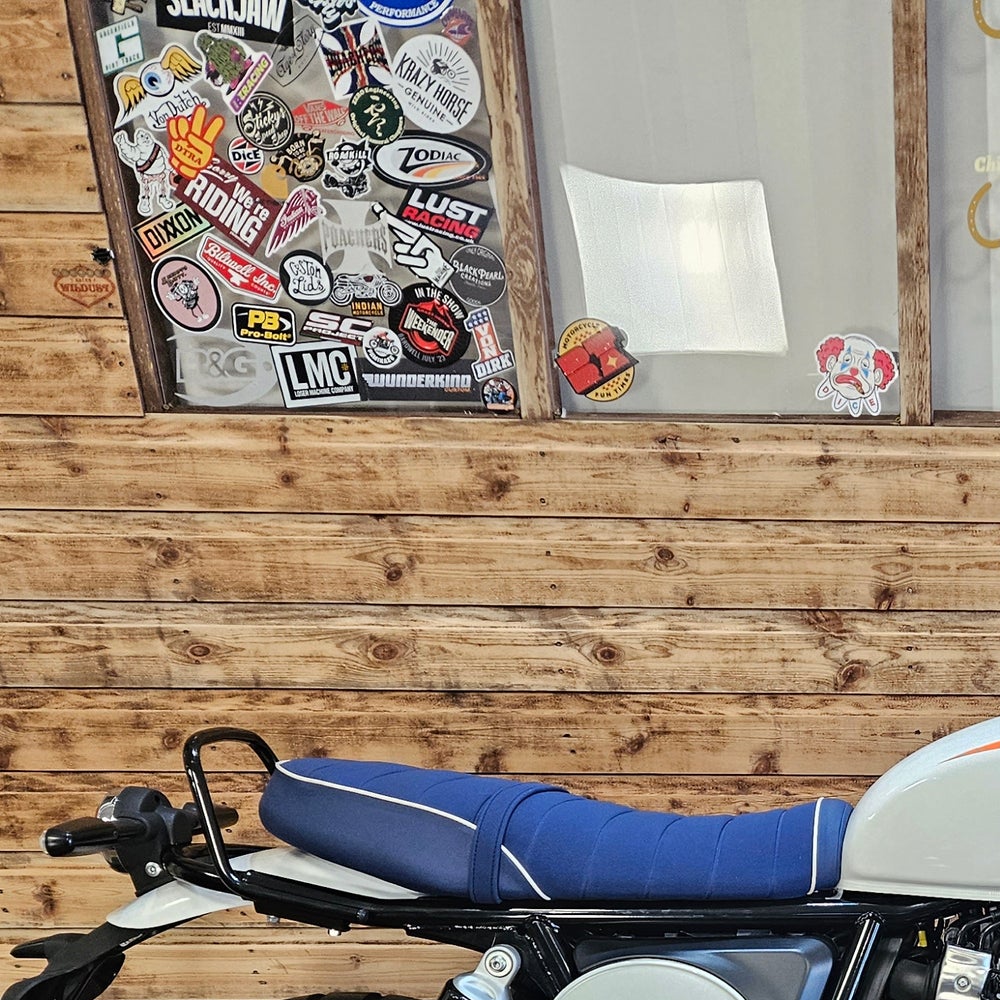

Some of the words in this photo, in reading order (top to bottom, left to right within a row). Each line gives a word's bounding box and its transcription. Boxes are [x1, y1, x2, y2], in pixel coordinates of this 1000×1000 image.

[368, 0, 440, 19] PERFORMANCE
[207, 21, 220, 33] EST
[394, 52, 435, 93] KRAZY
[433, 83, 473, 125] HORSE
[404, 87, 446, 122] GENUINE
[174, 143, 203, 165] DTRA
[285, 139, 306, 156] BORN
[398, 147, 462, 174] ZODIAC
[183, 173, 264, 245] RIDING
[231, 182, 271, 221] We're
[407, 187, 488, 226] LUST
[143, 208, 204, 250] DIXXON
[402, 205, 480, 239] RACING
[204, 241, 257, 279] Biltwell
[252, 271, 276, 294] Inc.
[292, 275, 326, 296] Lids
[351, 301, 383, 311] INDIAN
[414, 287, 426, 299] IN
[425, 286, 443, 301] THE
[441, 294, 465, 320] SHOW
[247, 309, 280, 331] PB
[302, 325, 365, 342] PROJECT
[305, 311, 374, 336] SC
[403, 307, 456, 352] WEEKENDER
[475, 325, 498, 359] VON
[284, 349, 352, 391] LMC
[362, 373, 472, 388] WUNDERKIND
[474, 353, 514, 379] DIRK
